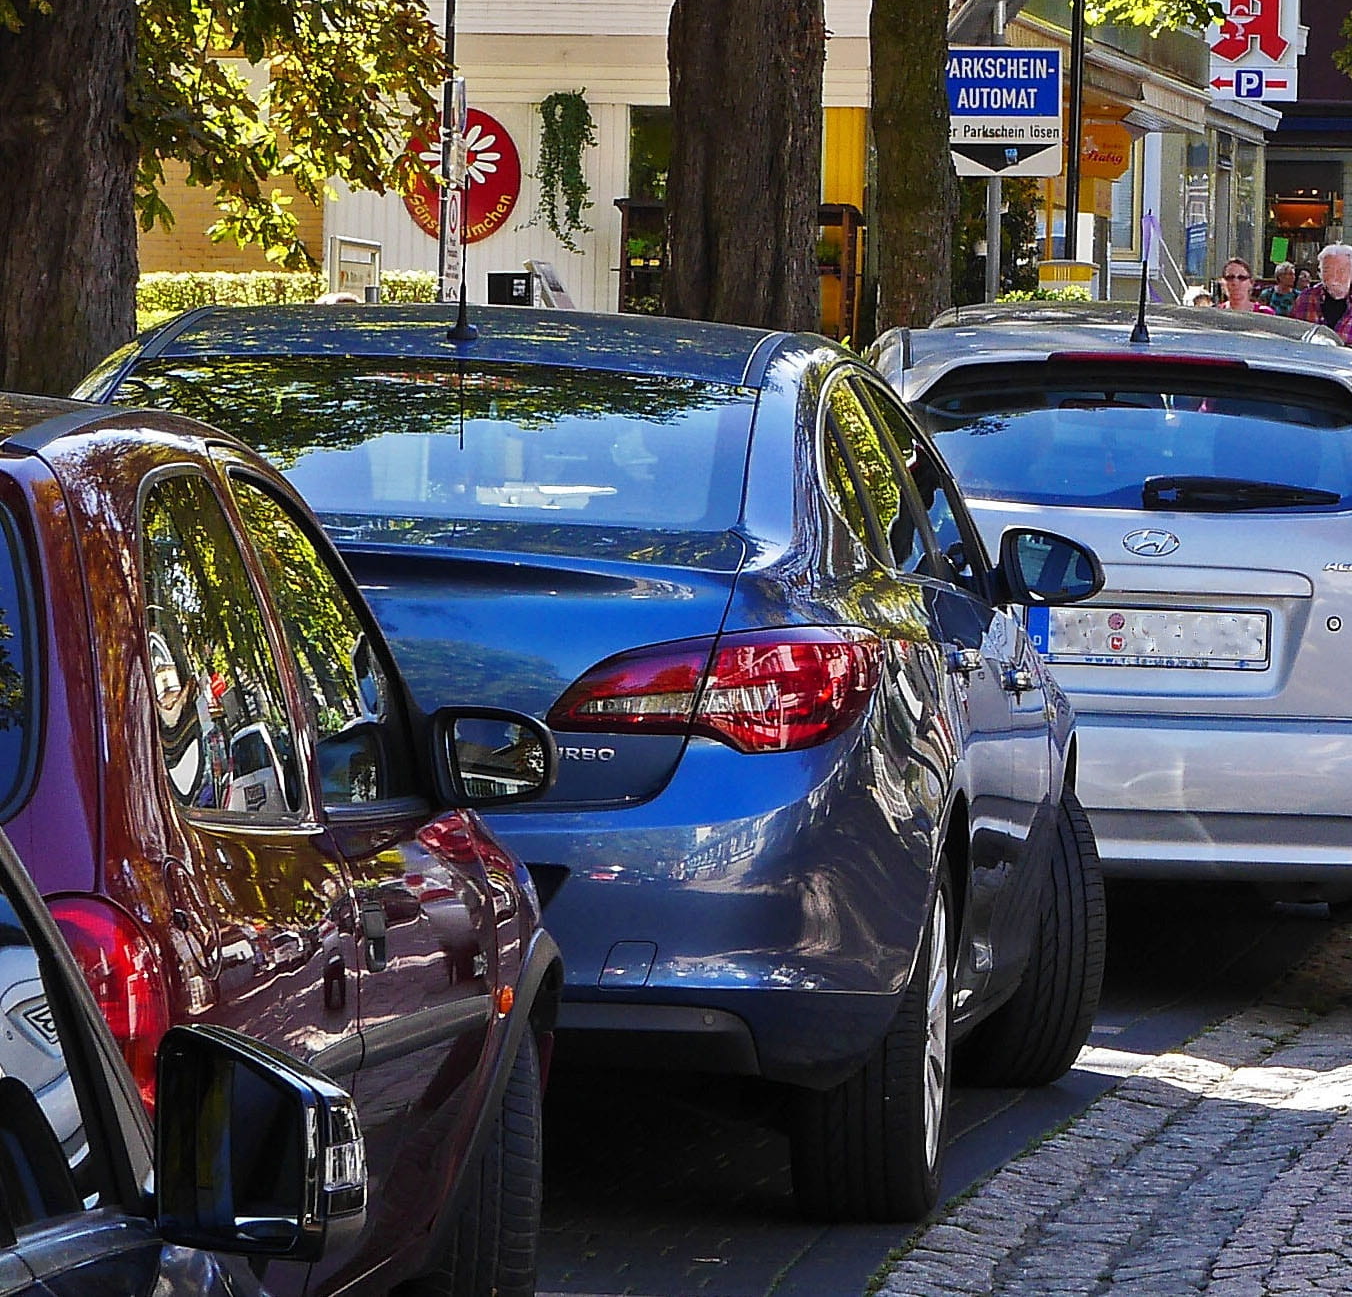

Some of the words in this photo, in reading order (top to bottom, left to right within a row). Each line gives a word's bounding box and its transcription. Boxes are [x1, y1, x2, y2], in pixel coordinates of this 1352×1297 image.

[957, 88, 1038, 109] AUTOMAT
[963, 124, 1025, 138] Parkschein
[1030, 124, 1060, 138] lösen
[557, 746, 616, 761] RBO
